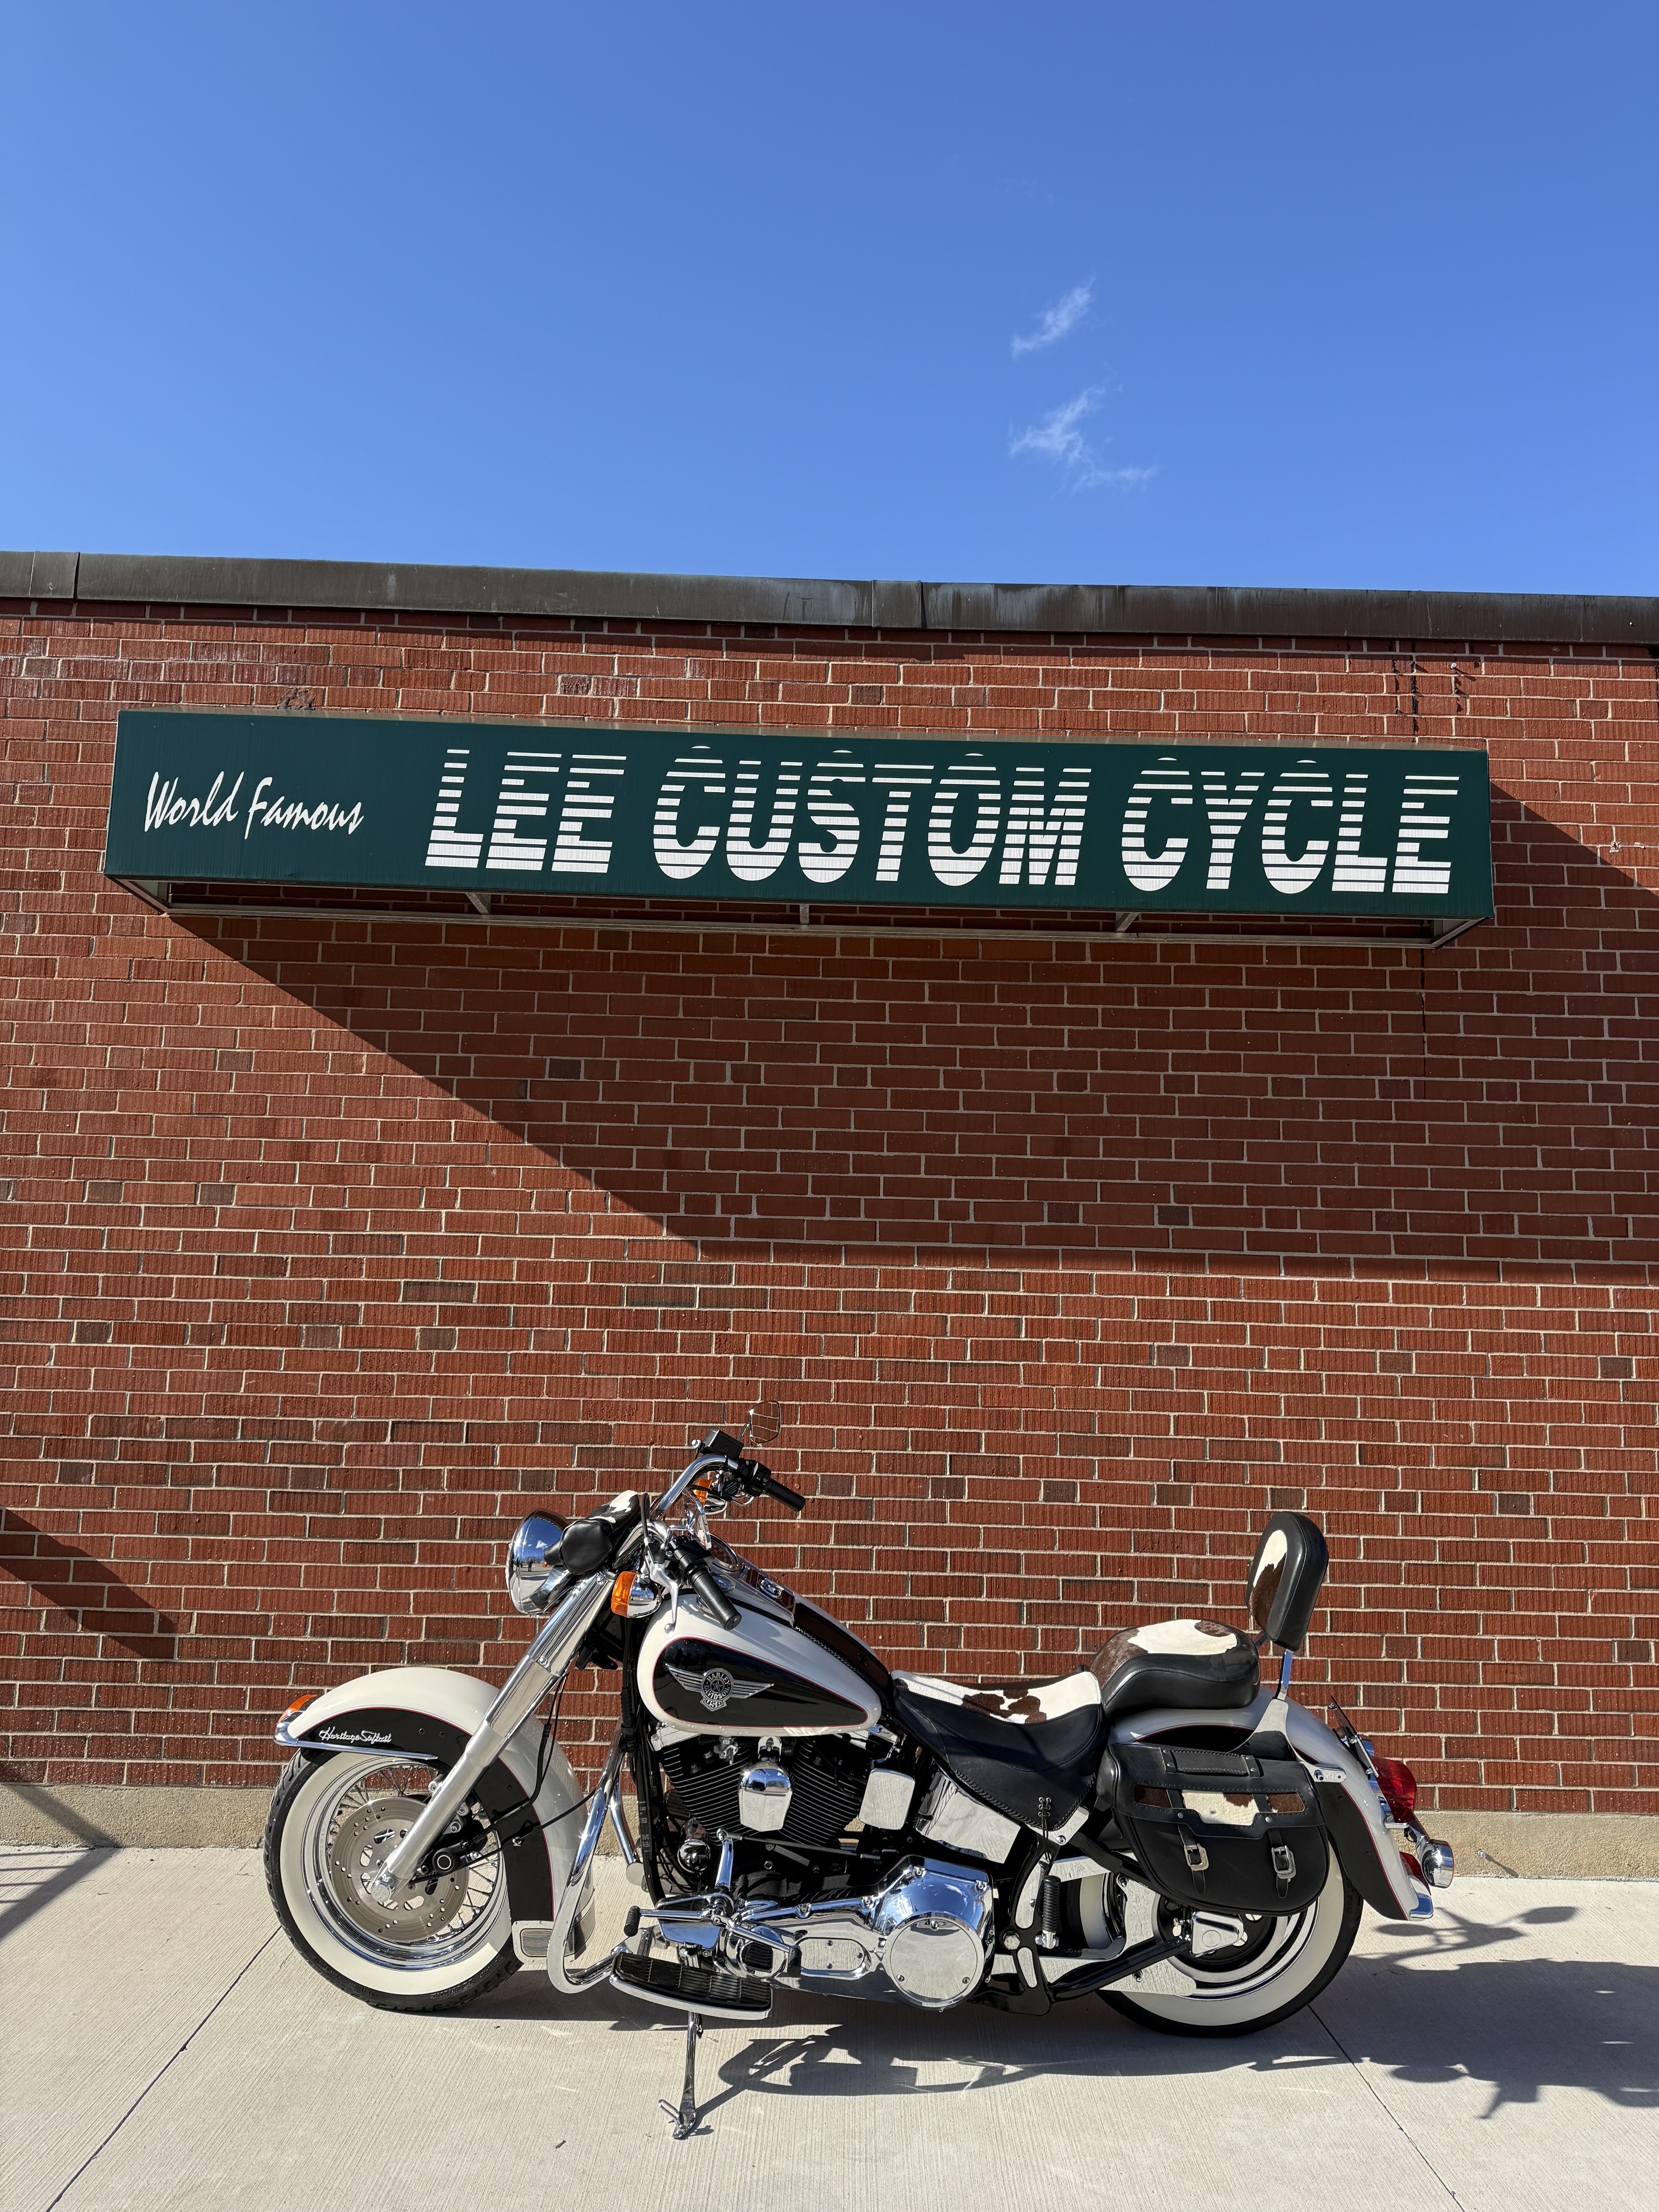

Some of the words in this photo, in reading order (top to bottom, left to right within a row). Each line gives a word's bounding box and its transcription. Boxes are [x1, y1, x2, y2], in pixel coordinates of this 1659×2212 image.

[145, 771, 244, 832] World
[243, 776, 364, 839] Famous
[425, 749, 627, 873] LEE
[653, 745, 1092, 886] CUSTOM
[1121, 757, 1459, 894] CYCLE
[705, 1699, 722, 1708] USA
[319, 1726, 361, 1743] Heritage
